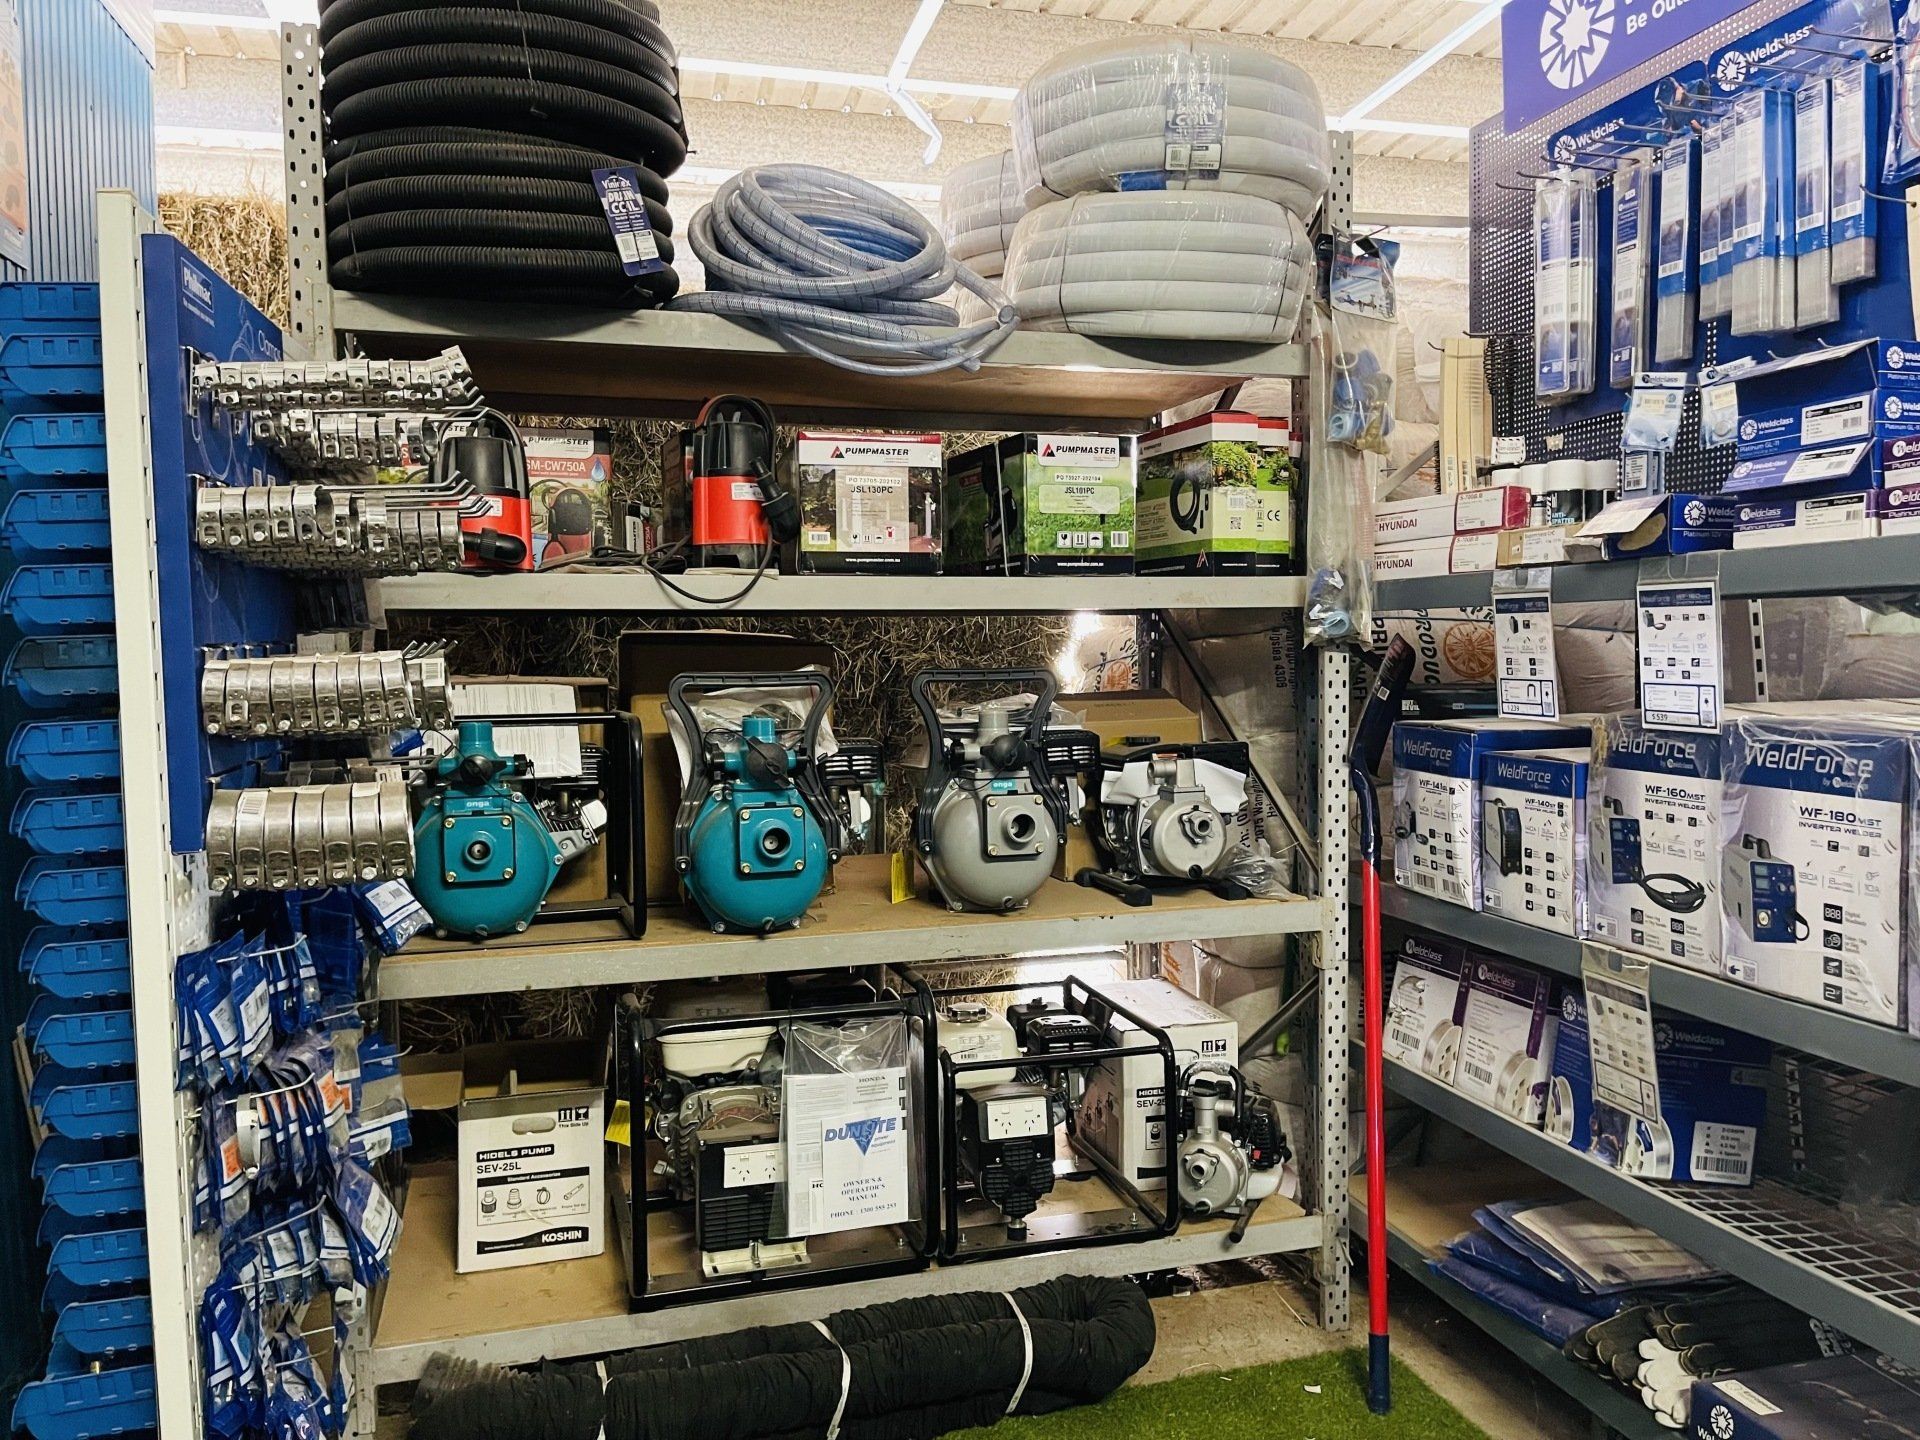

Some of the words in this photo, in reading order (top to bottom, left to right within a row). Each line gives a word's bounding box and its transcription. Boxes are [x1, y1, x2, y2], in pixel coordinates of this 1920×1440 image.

[1626, 12, 1648, 35] Be
[1758, 417, 1794, 429] Weldclass
[845, 446, 909, 456] PUMPMASTER
[1056, 445, 1116, 455] PUMPMASTER
[1740, 443, 1765, 453] Platinum
[850, 485, 894, 494] JSL130PC
[1267, 509, 1281, 521] CE
[1740, 507, 1781, 521] Weldclass
[1379, 518, 1418, 531] HYUNDAI
[1376, 558, 1413, 570] HYUNDAI
[1403, 738, 1453, 760] WeldForce
[1608, 729, 1696, 759] WeldForce
[1745, 741, 1874, 778] WeldForce
[1498, 761, 1551, 784] WeldForce
[1645, 784, 1706, 801] WF-160MST
[1645, 797, 1677, 807] INVERTER
[1677, 802, 1706, 811] WELDER
[1799, 821, 1841, 833] INVERTER
[1844, 828, 1882, 838] WELDER
[1405, 938, 1443, 962] Weldclass
[1477, 963, 1516, 988] Weldclass
[521, 1146, 552, 1156] PUMP
[476, 1162, 522, 1174] SEV-25L
[507, 1174, 530, 1182] Standard
[841, 1183, 886, 1196] OPERATOR'S
[848, 1192, 877, 1202] MANUAL
[830, 1209, 854, 1218] PHONE
[541, 1229, 582, 1243] KOSHIN
